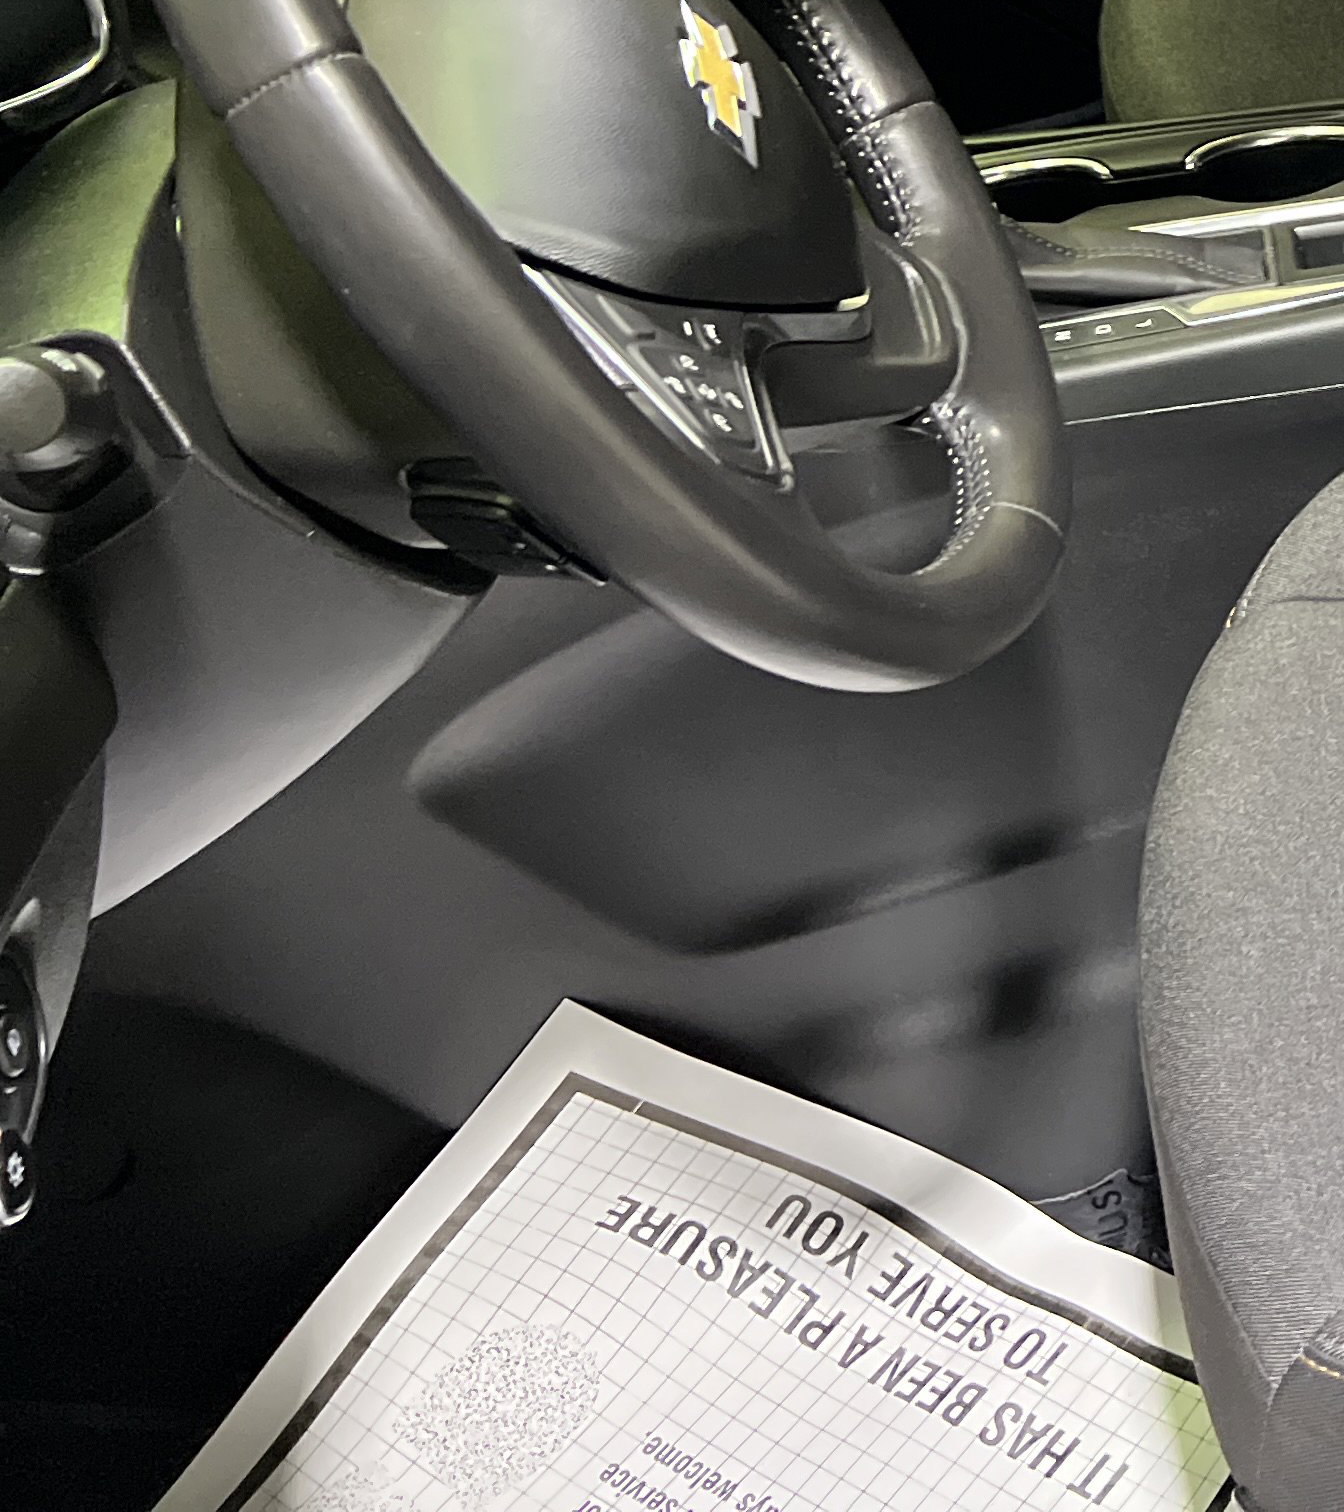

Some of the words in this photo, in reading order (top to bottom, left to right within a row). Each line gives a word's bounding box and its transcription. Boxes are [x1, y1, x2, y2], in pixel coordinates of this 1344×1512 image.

[594, 1194, 847, 1350] PLEASURE
[765, 1194, 869, 1280] YOU
[867, 1252, 1011, 1351] SERVE
[838, 1324, 885, 1369] A
[1003, 1328, 1068, 1386] TO
[868, 1346, 988, 1426] BEEN
[979, 1402, 1081, 1478] HAS
[1066, 1453, 1129, 1505] IT
